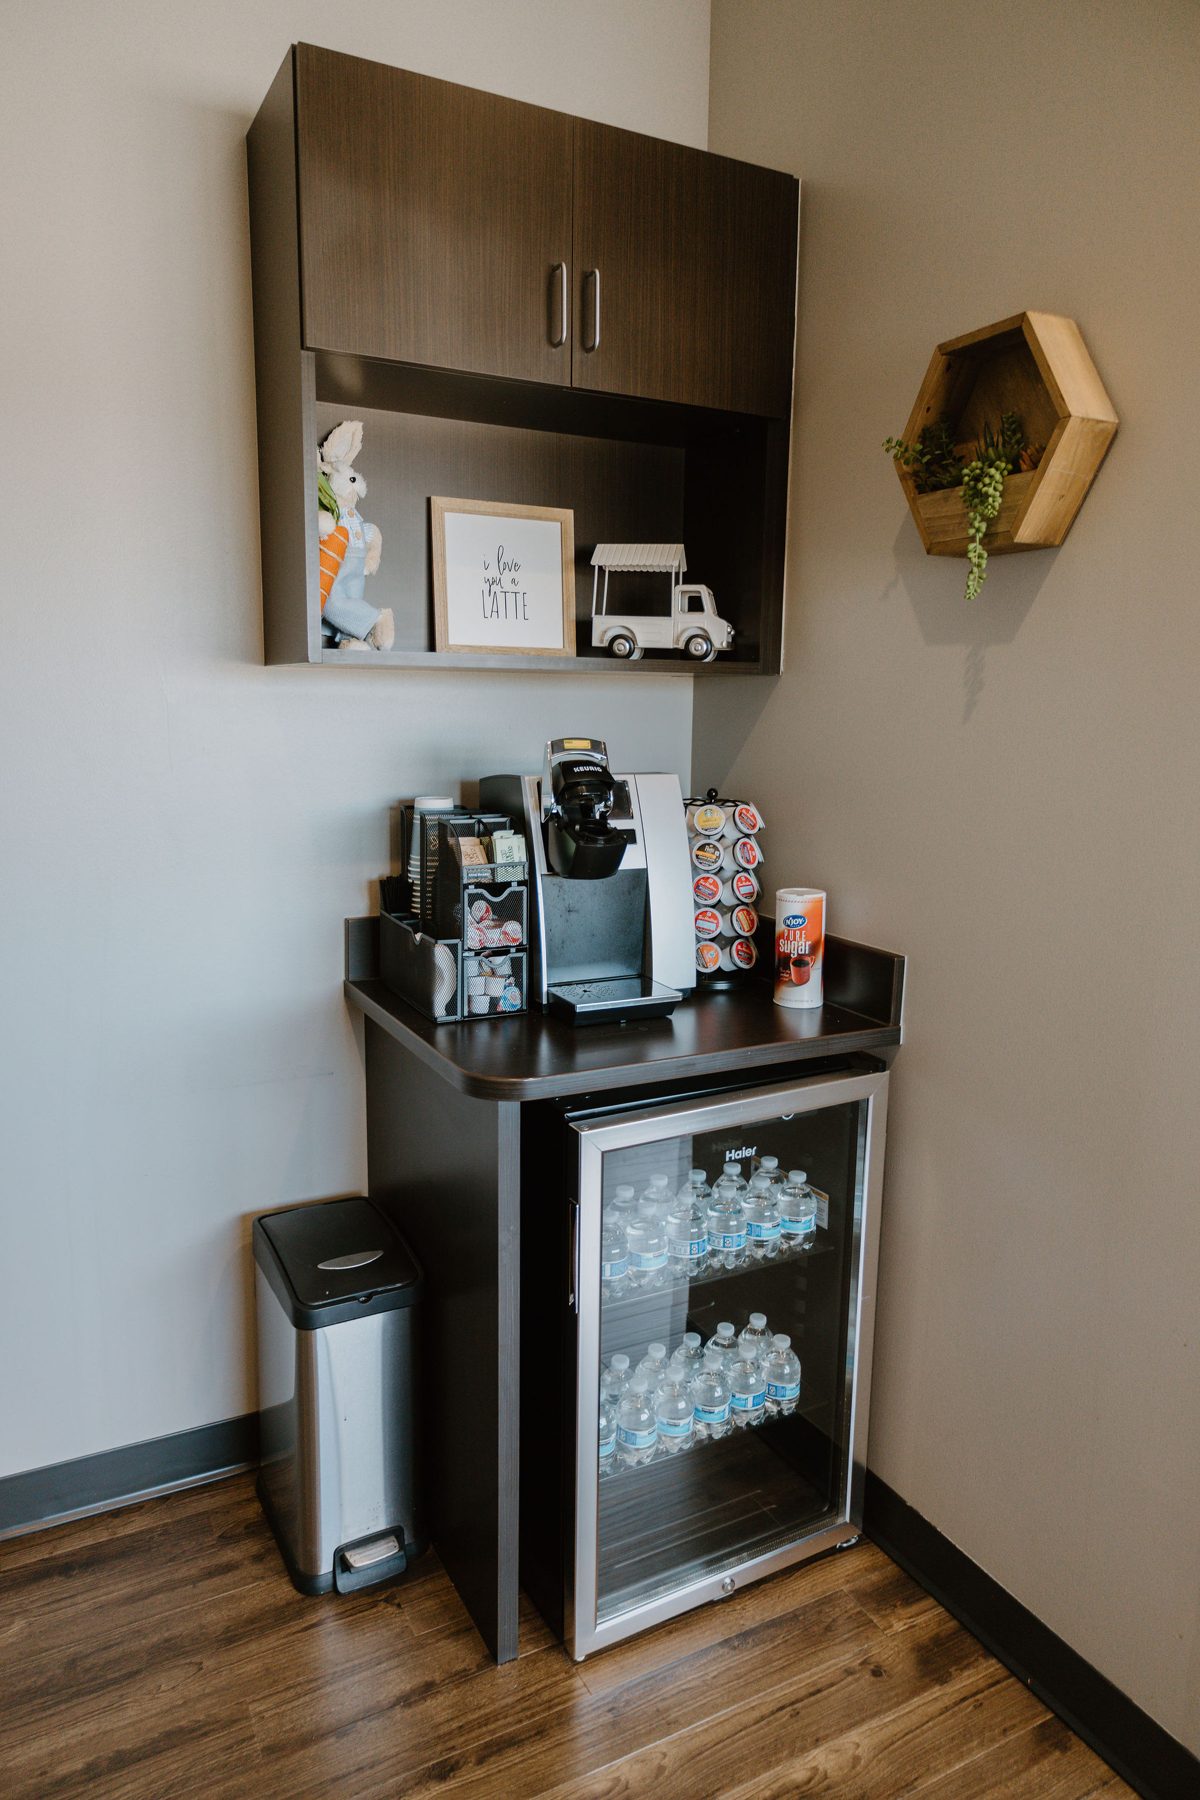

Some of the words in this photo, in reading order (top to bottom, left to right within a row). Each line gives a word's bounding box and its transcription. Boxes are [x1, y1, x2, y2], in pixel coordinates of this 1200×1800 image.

[483, 553, 490, 571] i
[497, 545, 521, 576] love
[484, 576, 504, 598] you
[510, 577, 519, 587] a
[482, 589, 529, 621] LATTE
[573, 765, 603, 773] KEURIG
[783, 929, 806, 942] PURE
[779, 939, 812, 958] sugar
[725, 1146, 757, 1162] Haier
